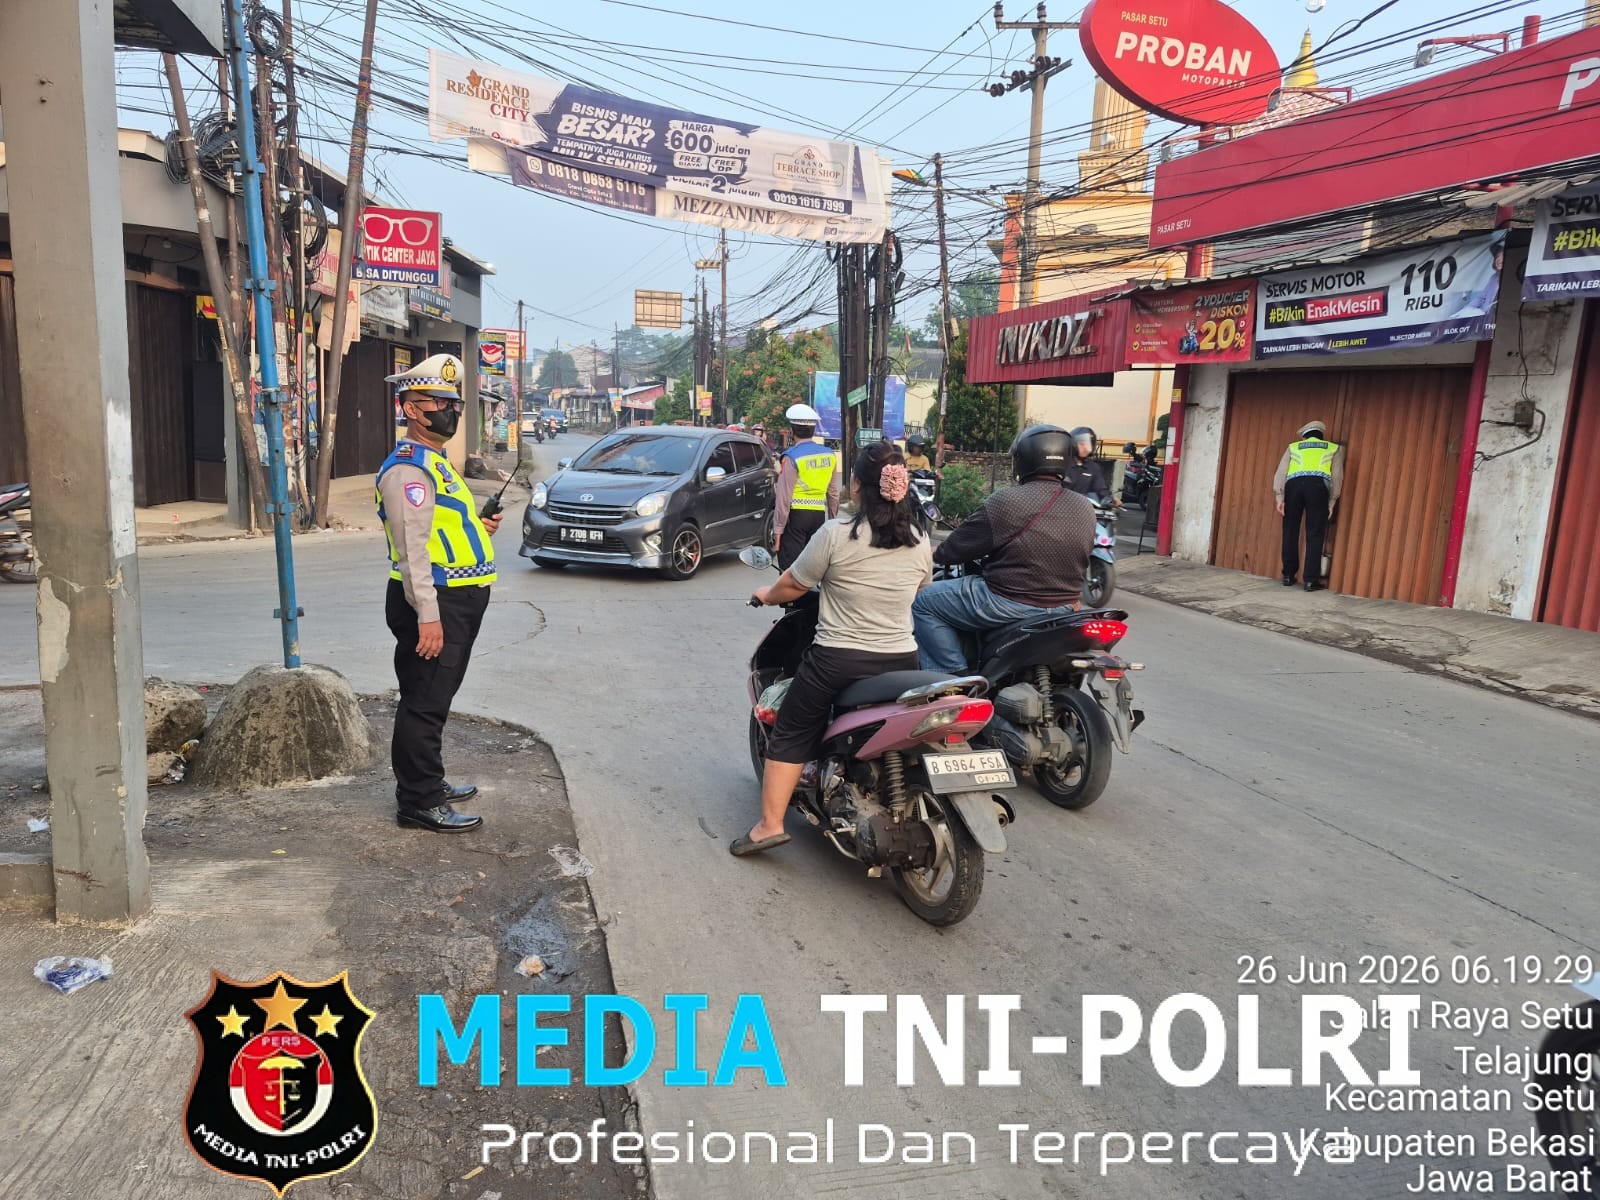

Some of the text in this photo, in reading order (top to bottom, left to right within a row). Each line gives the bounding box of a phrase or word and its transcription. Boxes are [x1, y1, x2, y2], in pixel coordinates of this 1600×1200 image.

[1121, 11, 1168, 27] PASAR SETU
[1114, 31, 1252, 77] PROBAN
[446, 79, 530, 111] RESIDENCE
[482, 77, 530, 99] GRAND
[490, 103, 530, 122] CITY
[571, 102, 653, 129] BISNIS MAU
[557, 113, 656, 148] BESAR?
[682, 122, 714, 133] HARGA
[556, 138, 652, 164] TEMPATNYA JUGA HARUS
[669, 130, 751, 155] 600 juta'an
[680, 154, 702, 162] FREE
[794, 158, 823, 168] GRAND
[776, 162, 816, 177] TERRACE
[818, 169, 841, 180] SHOP
[711, 175, 726, 193] 2
[673, 194, 776, 225] MEZZANINE
[1157, 219, 1192, 235] PASAR SETU
[381, 246, 415, 264] CENTER
[416, 249, 436, 266] JAYA
[356, 267, 434, 284] BSA DITUNGGU
[1266, 270, 1366, 299] SERVIS MOTOR
[1401, 256, 1458, 296] 110
[1537, 279, 1600, 293] TARIKAN LEB
[1210, 304, 1249, 318] DISKON
[1269, 295, 1380, 323] #Bikin EnakMesin
[1405, 293, 1443, 312] RIBU
[1349, 337, 1367, 346] AWET
[931, 761, 939, 774] B
[944, 758, 975, 772] 6964
